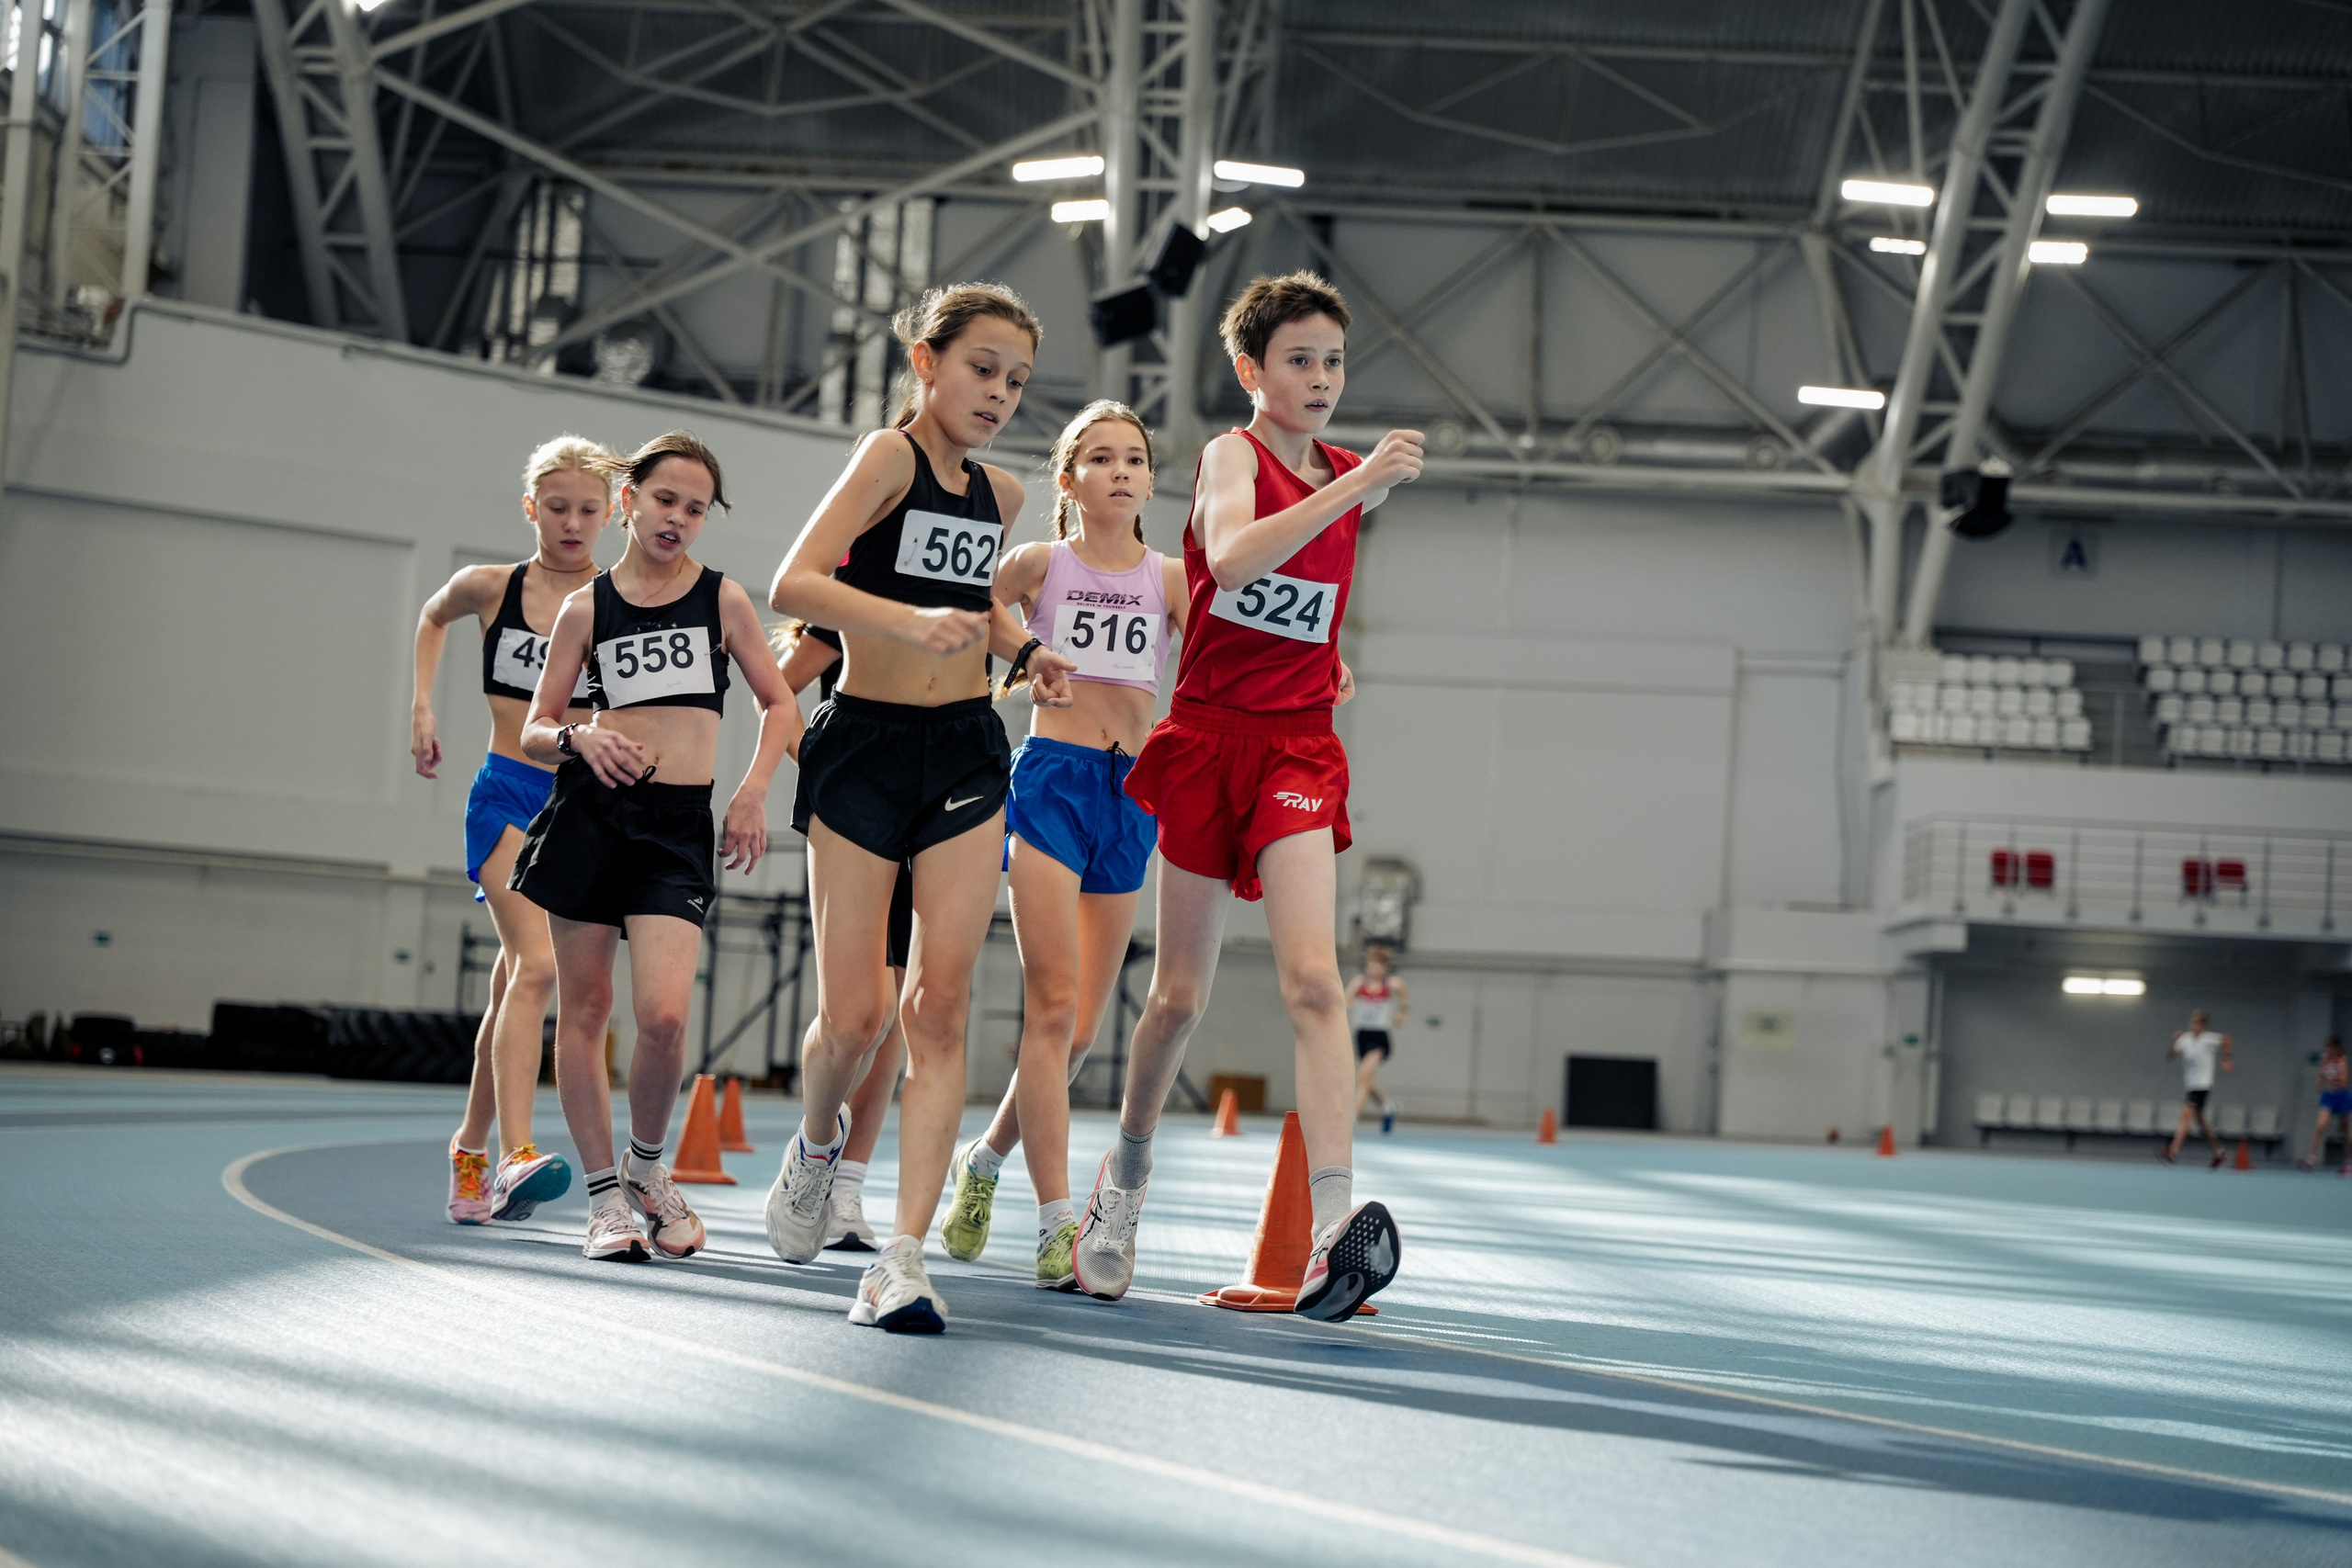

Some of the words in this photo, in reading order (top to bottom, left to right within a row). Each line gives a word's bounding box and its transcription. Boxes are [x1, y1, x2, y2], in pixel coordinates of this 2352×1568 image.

[922, 526, 996, 581] 562
[2060, 537, 2089, 571] A
[1066, 590, 1143, 606] DEMIX
[1237, 578, 1324, 632] 524
[1071, 610, 1147, 654] 516
[616, 632, 694, 679] 558
[1272, 791, 1323, 812] RAY
